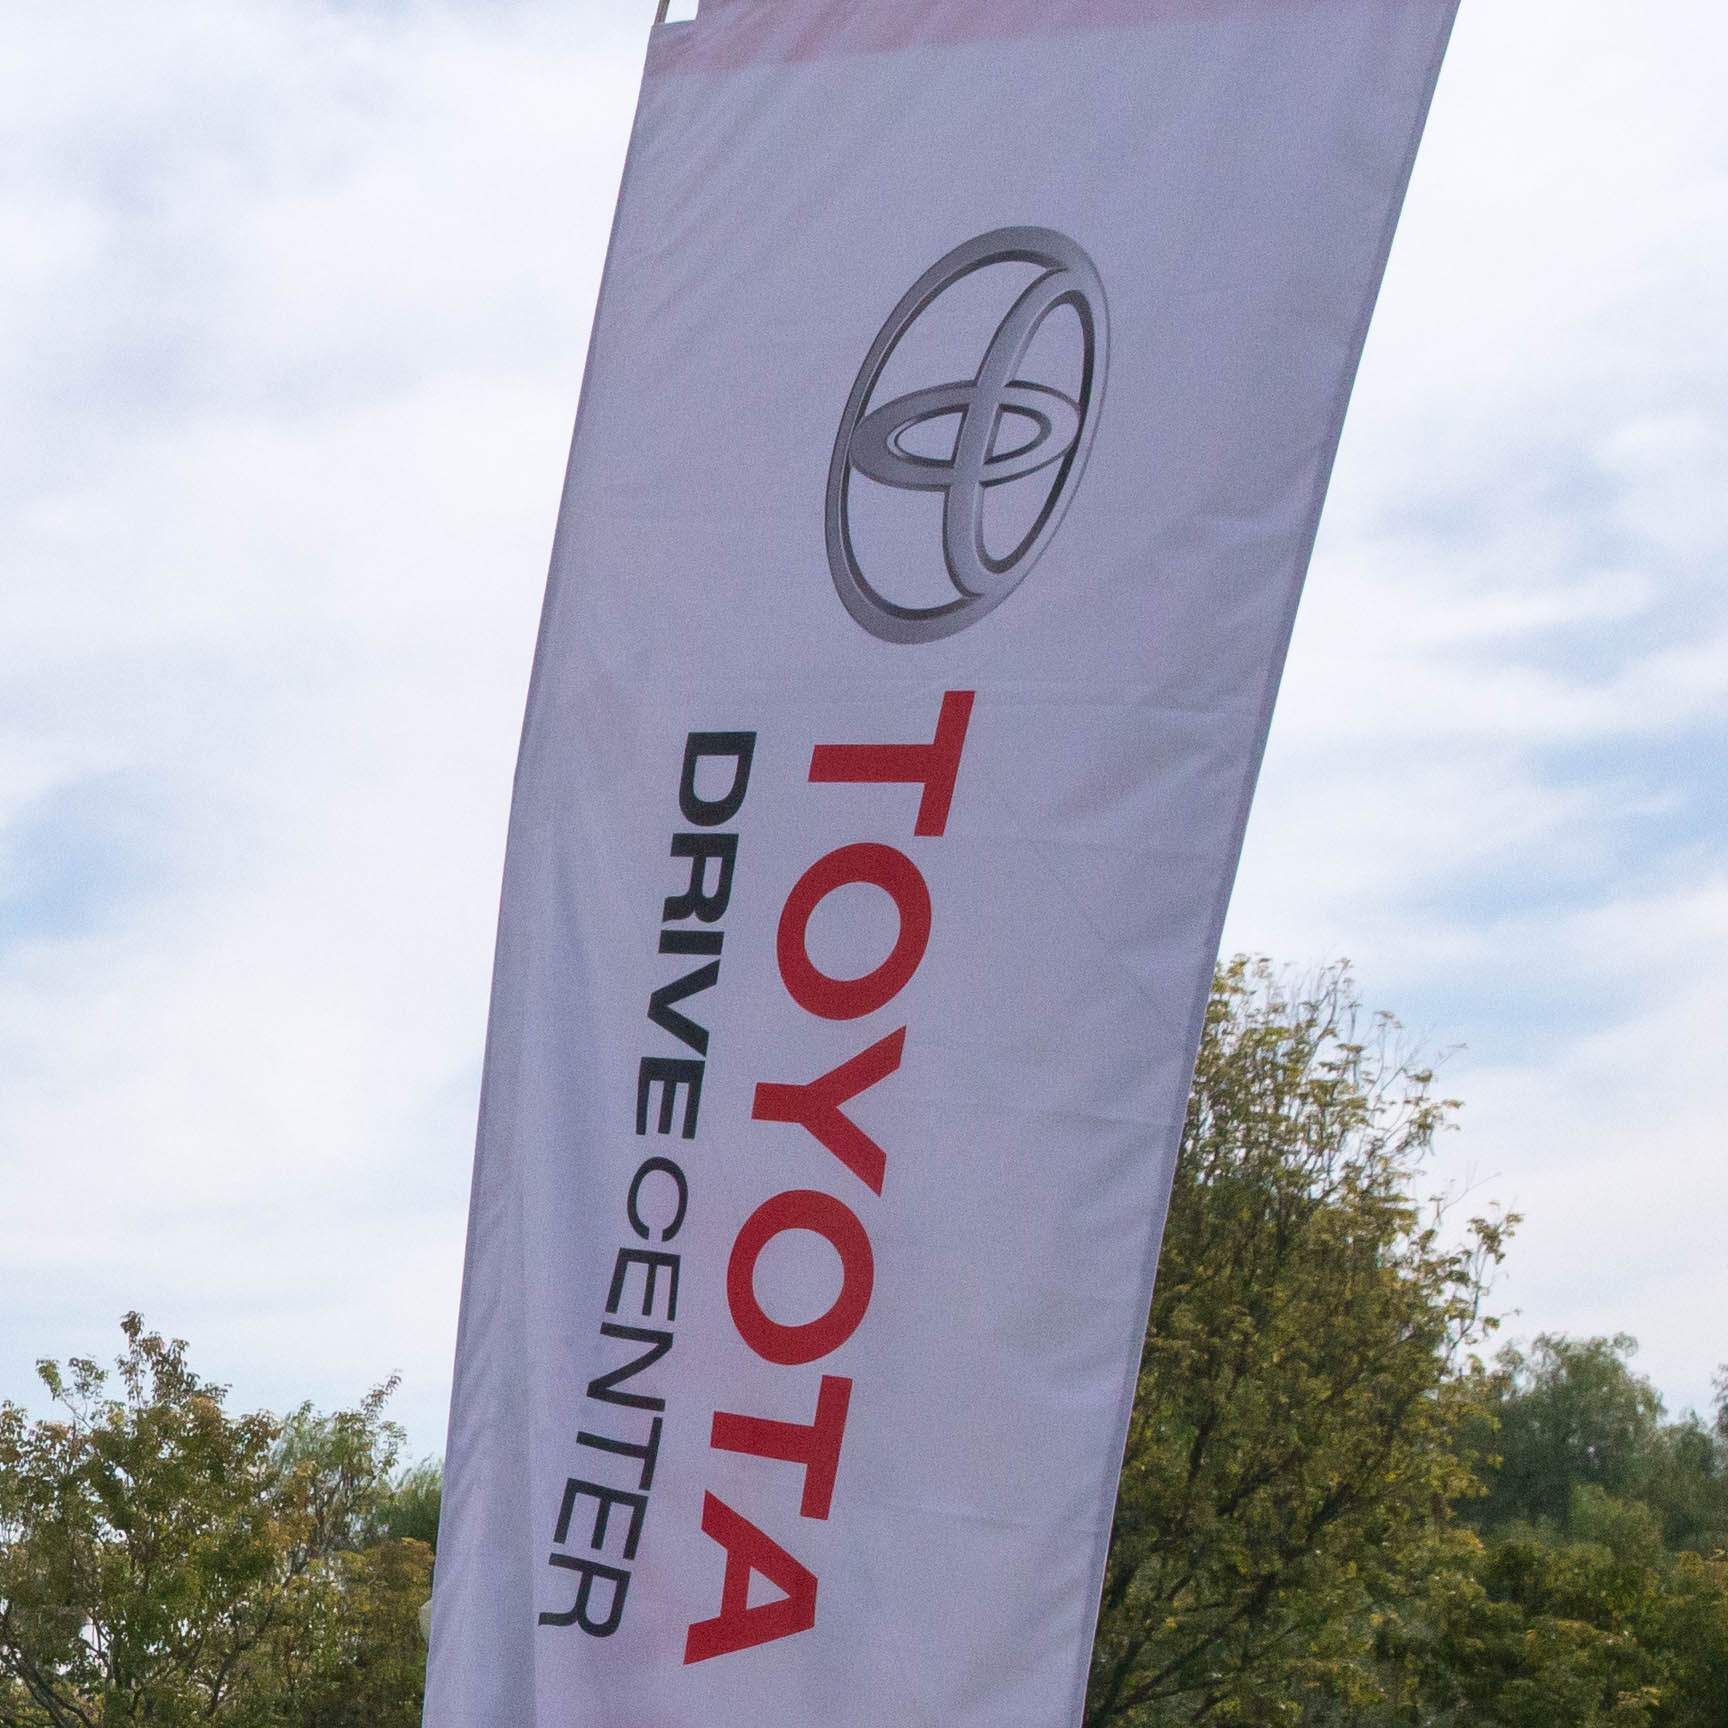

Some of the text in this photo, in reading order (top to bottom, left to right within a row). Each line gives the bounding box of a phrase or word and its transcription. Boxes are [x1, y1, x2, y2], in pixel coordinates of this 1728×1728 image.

[537, 730, 757, 1639] DRIVE CENTER
[682, 689, 976, 1666] TOYOTA
